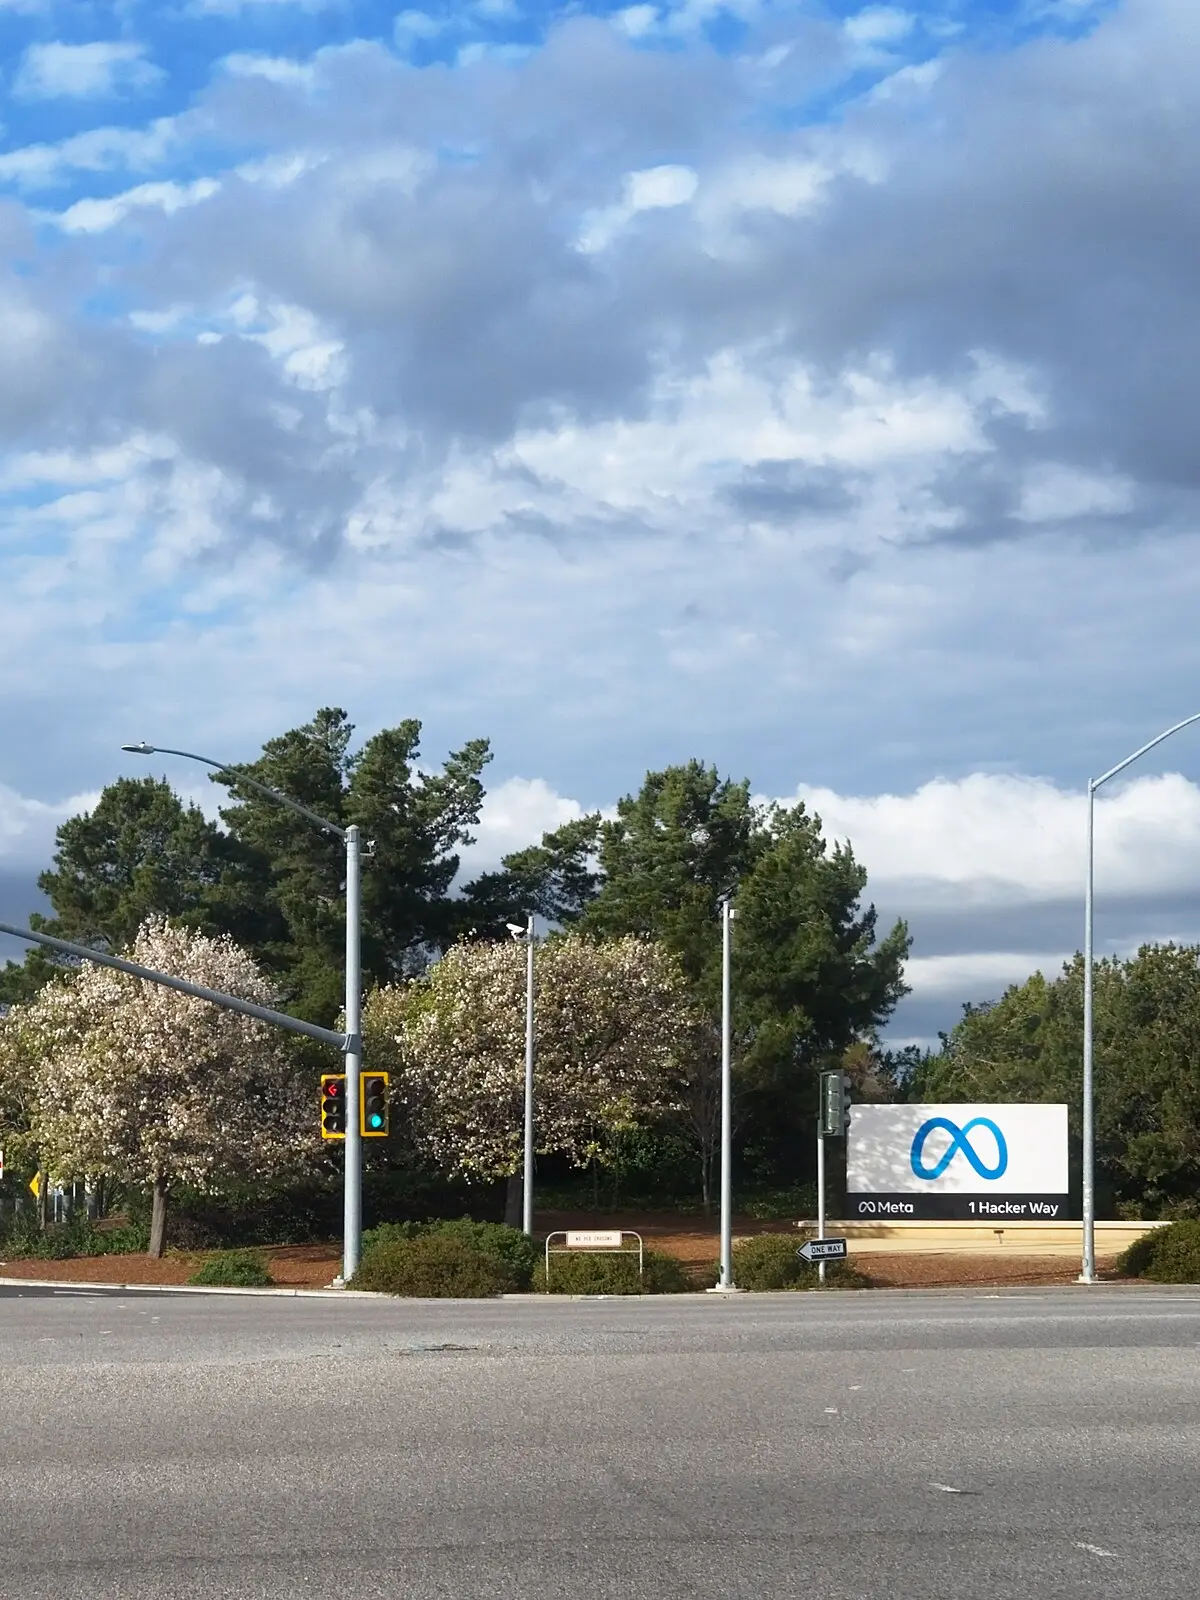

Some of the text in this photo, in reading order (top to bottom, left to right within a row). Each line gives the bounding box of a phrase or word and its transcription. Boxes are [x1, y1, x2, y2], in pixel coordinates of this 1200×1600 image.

[877, 1201, 914, 1213] Meta
[968, 1201, 1059, 1217] 1 Hacker Way
